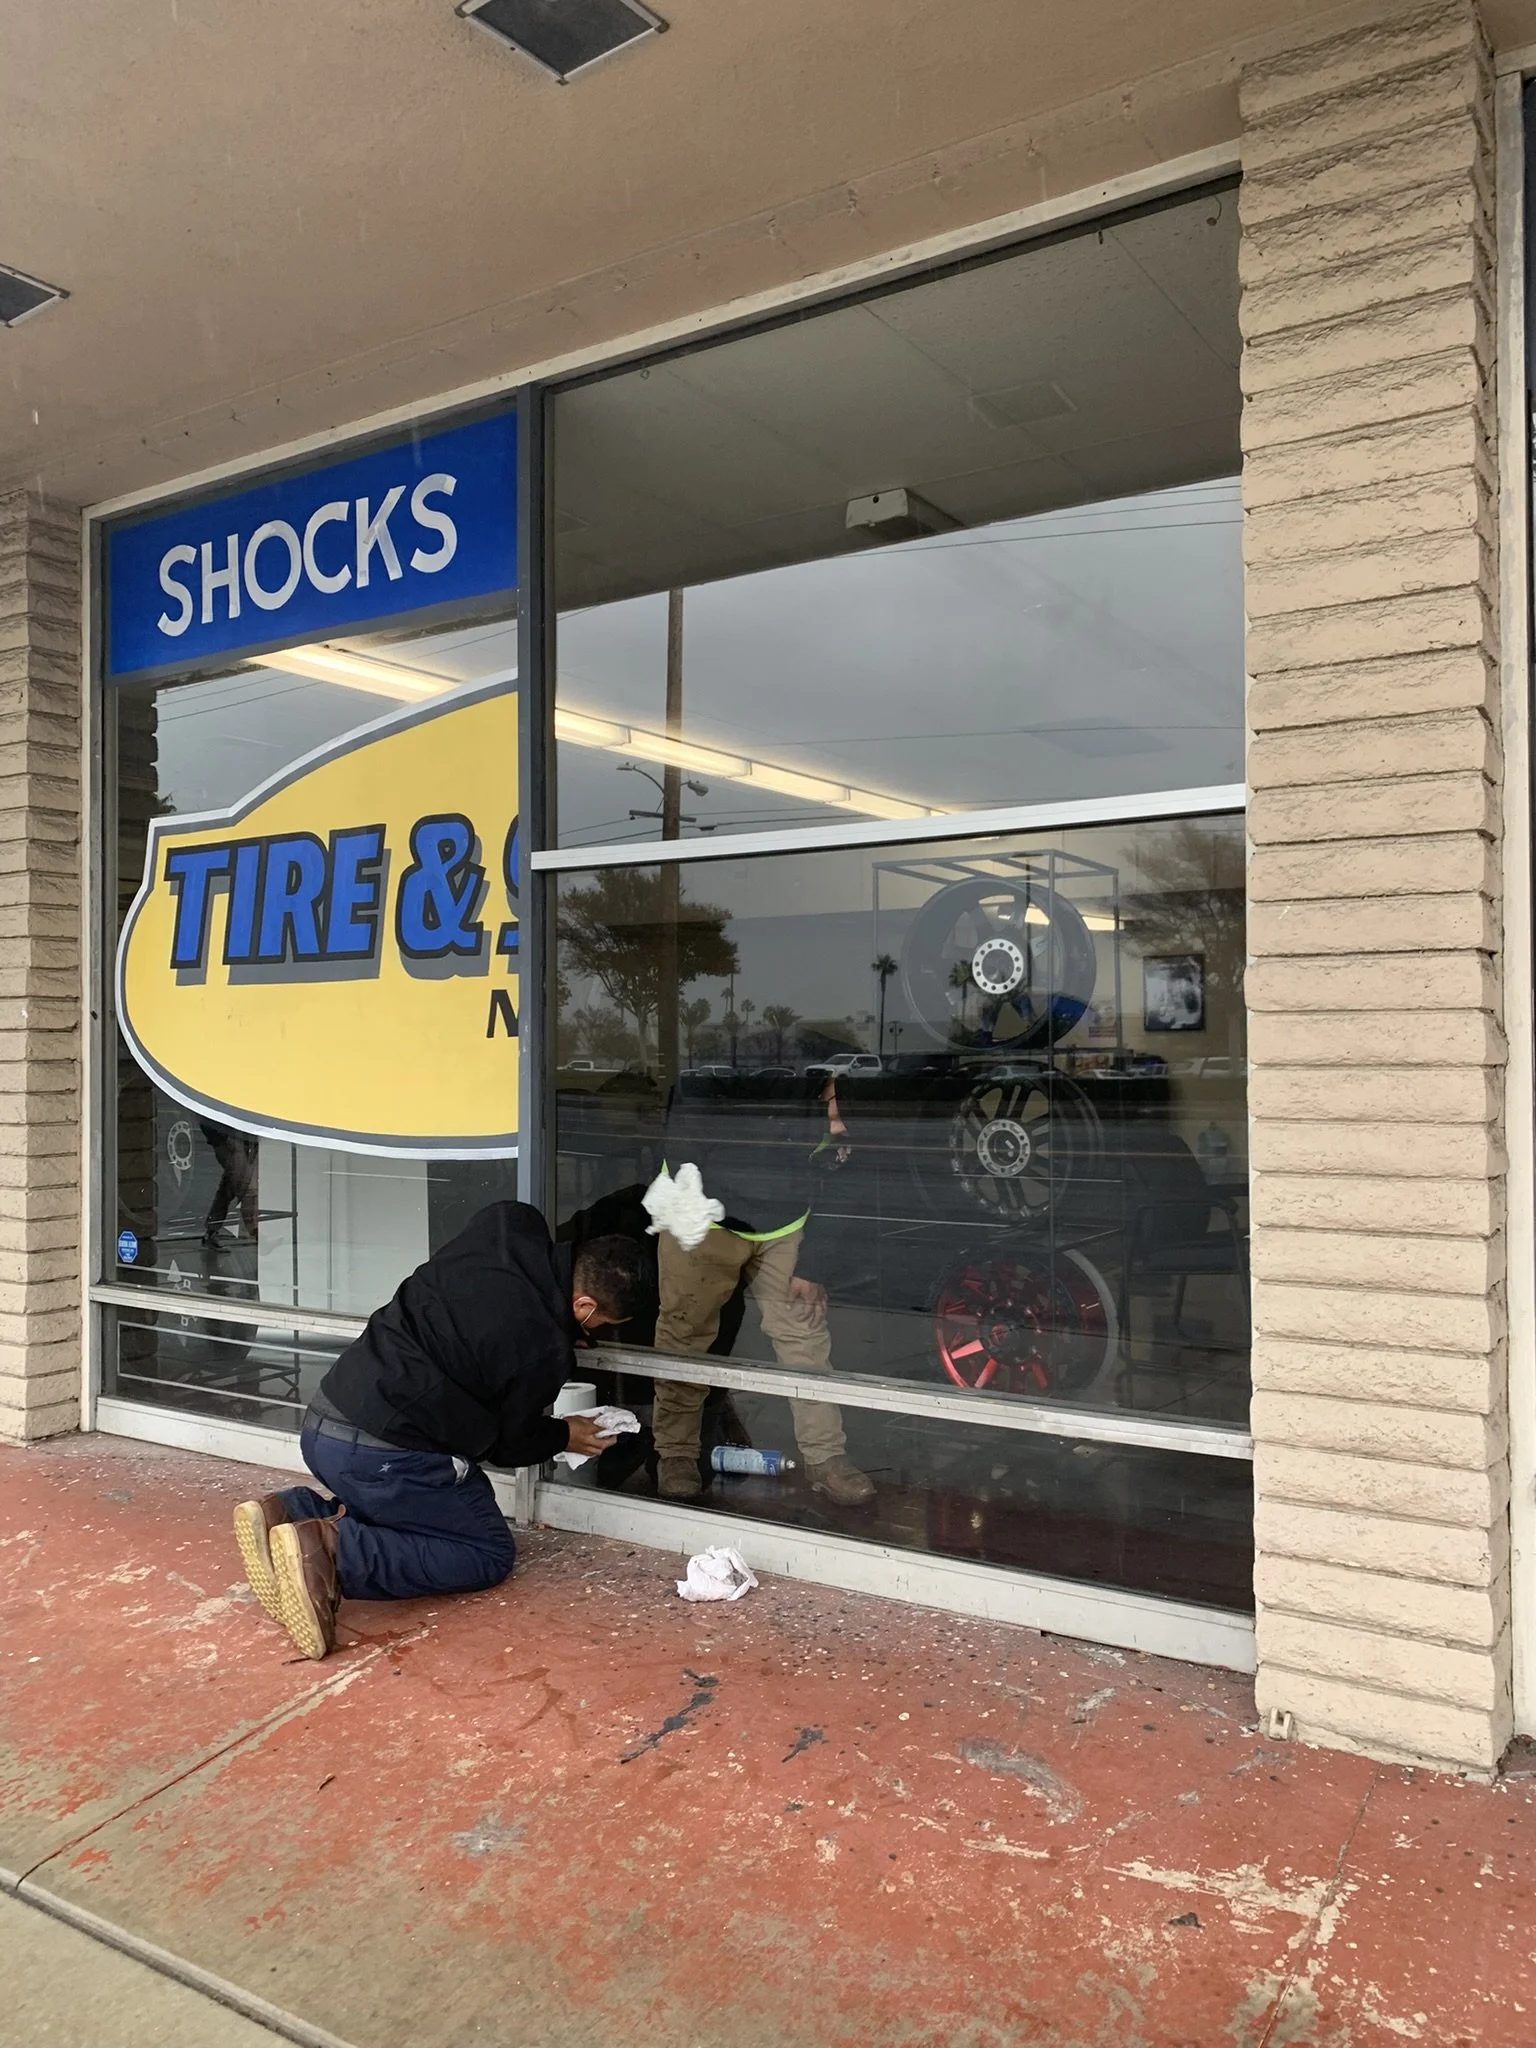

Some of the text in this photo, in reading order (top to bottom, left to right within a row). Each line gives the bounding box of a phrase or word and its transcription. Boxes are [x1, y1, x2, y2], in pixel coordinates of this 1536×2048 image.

[157, 473, 458, 637] SHOCKS
[164, 823, 388, 976] TIRE
[395, 813, 488, 967] &
